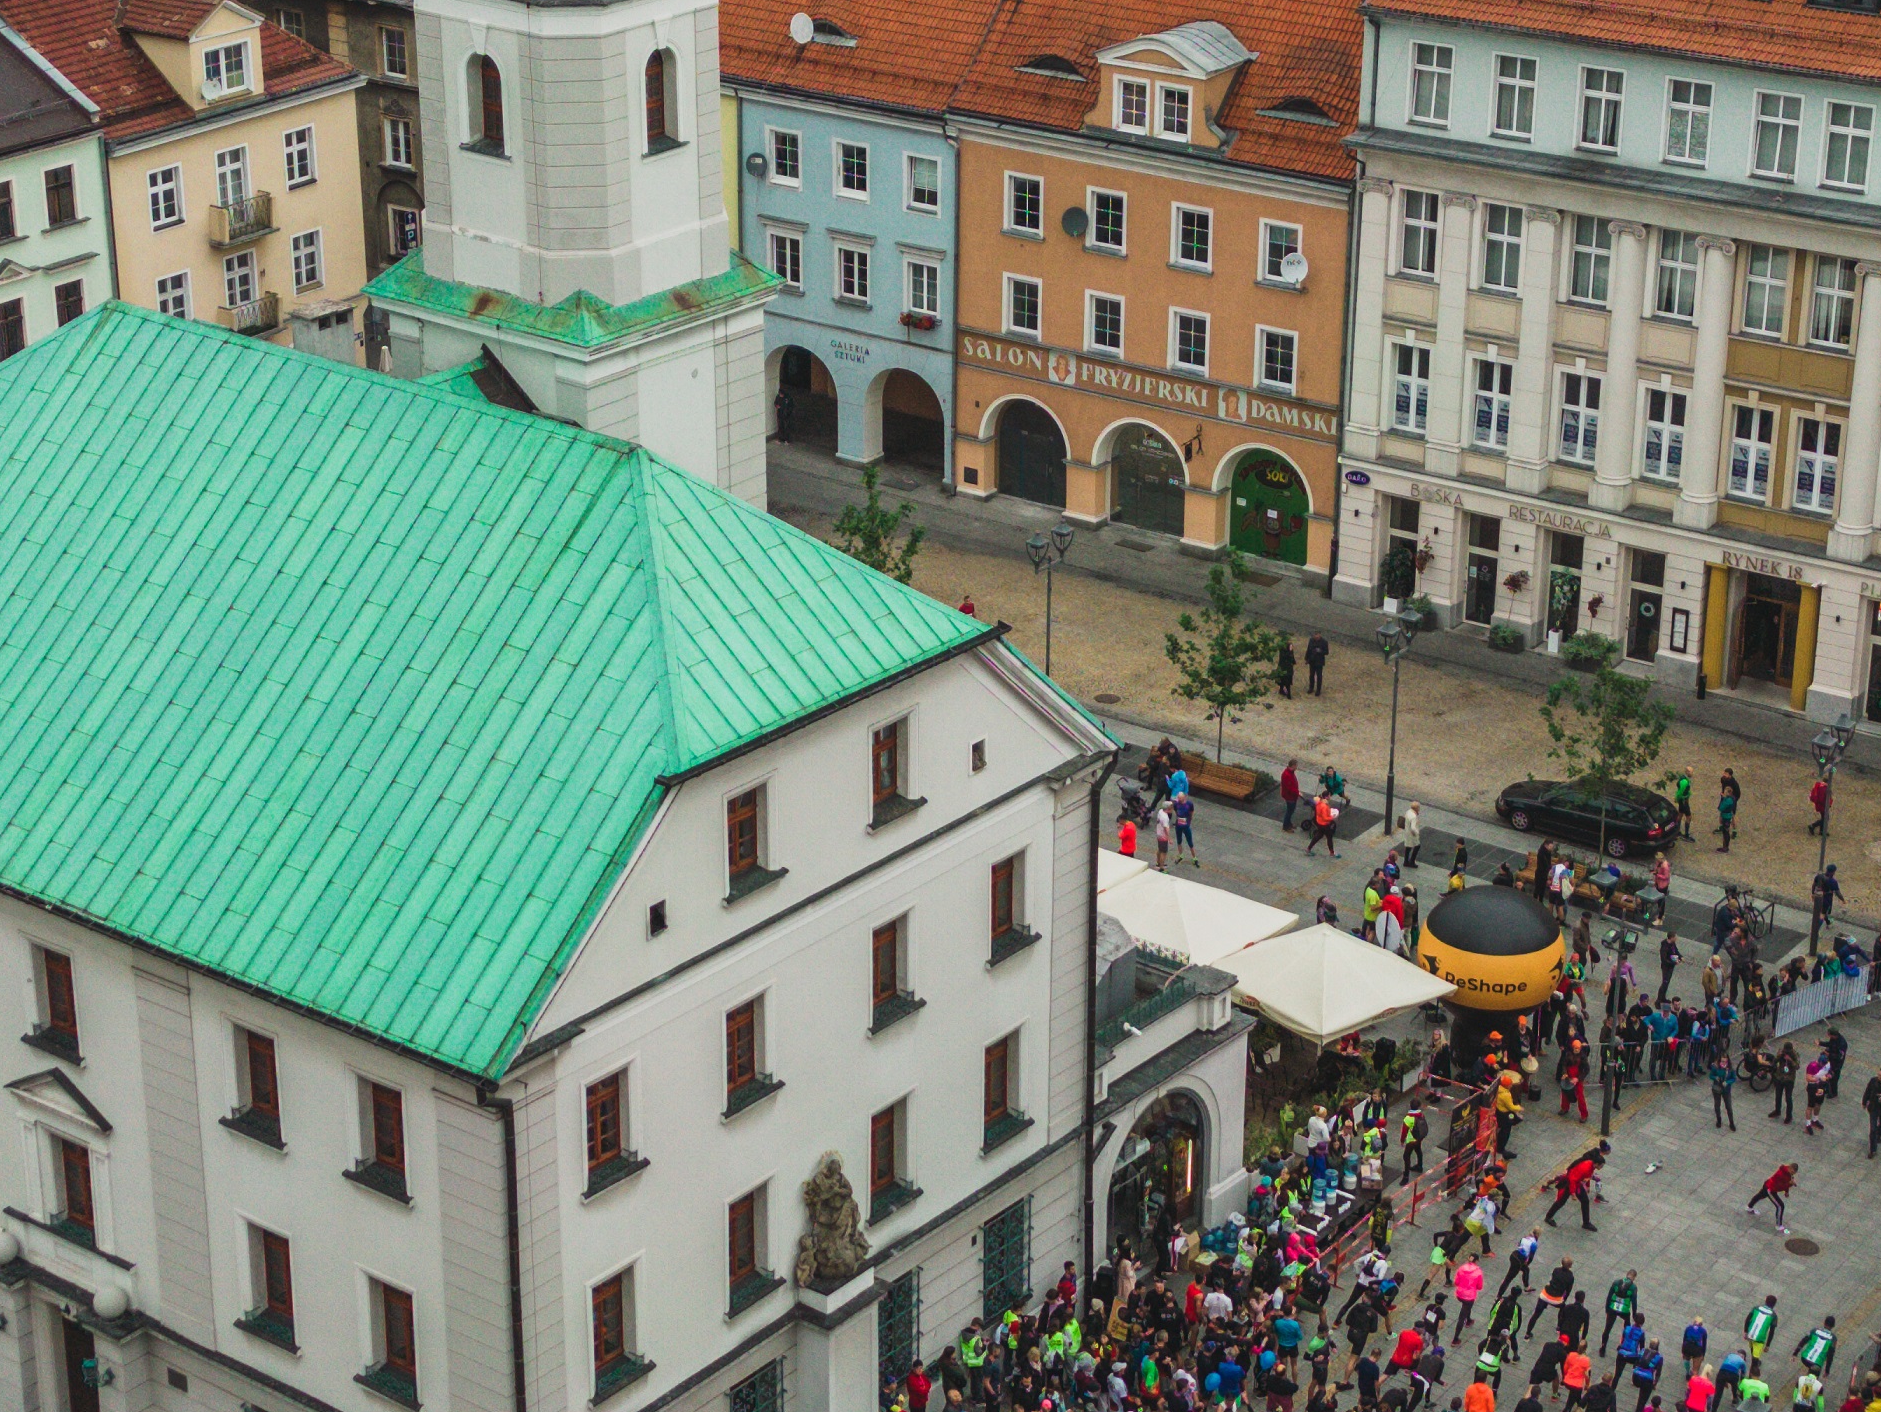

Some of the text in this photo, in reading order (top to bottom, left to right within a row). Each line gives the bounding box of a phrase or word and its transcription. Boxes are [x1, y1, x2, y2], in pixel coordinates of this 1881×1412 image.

[831, 339, 870, 356] GALERIA
[834, 350, 865, 364] SZTUKI
[1081, 362, 1209, 408] FRYZJERSKI
[1509, 504, 1612, 539] RESTAURACJA
[1722, 550, 1803, 579] RYNEK 18
[1445, 970, 1528, 996] ReShape
